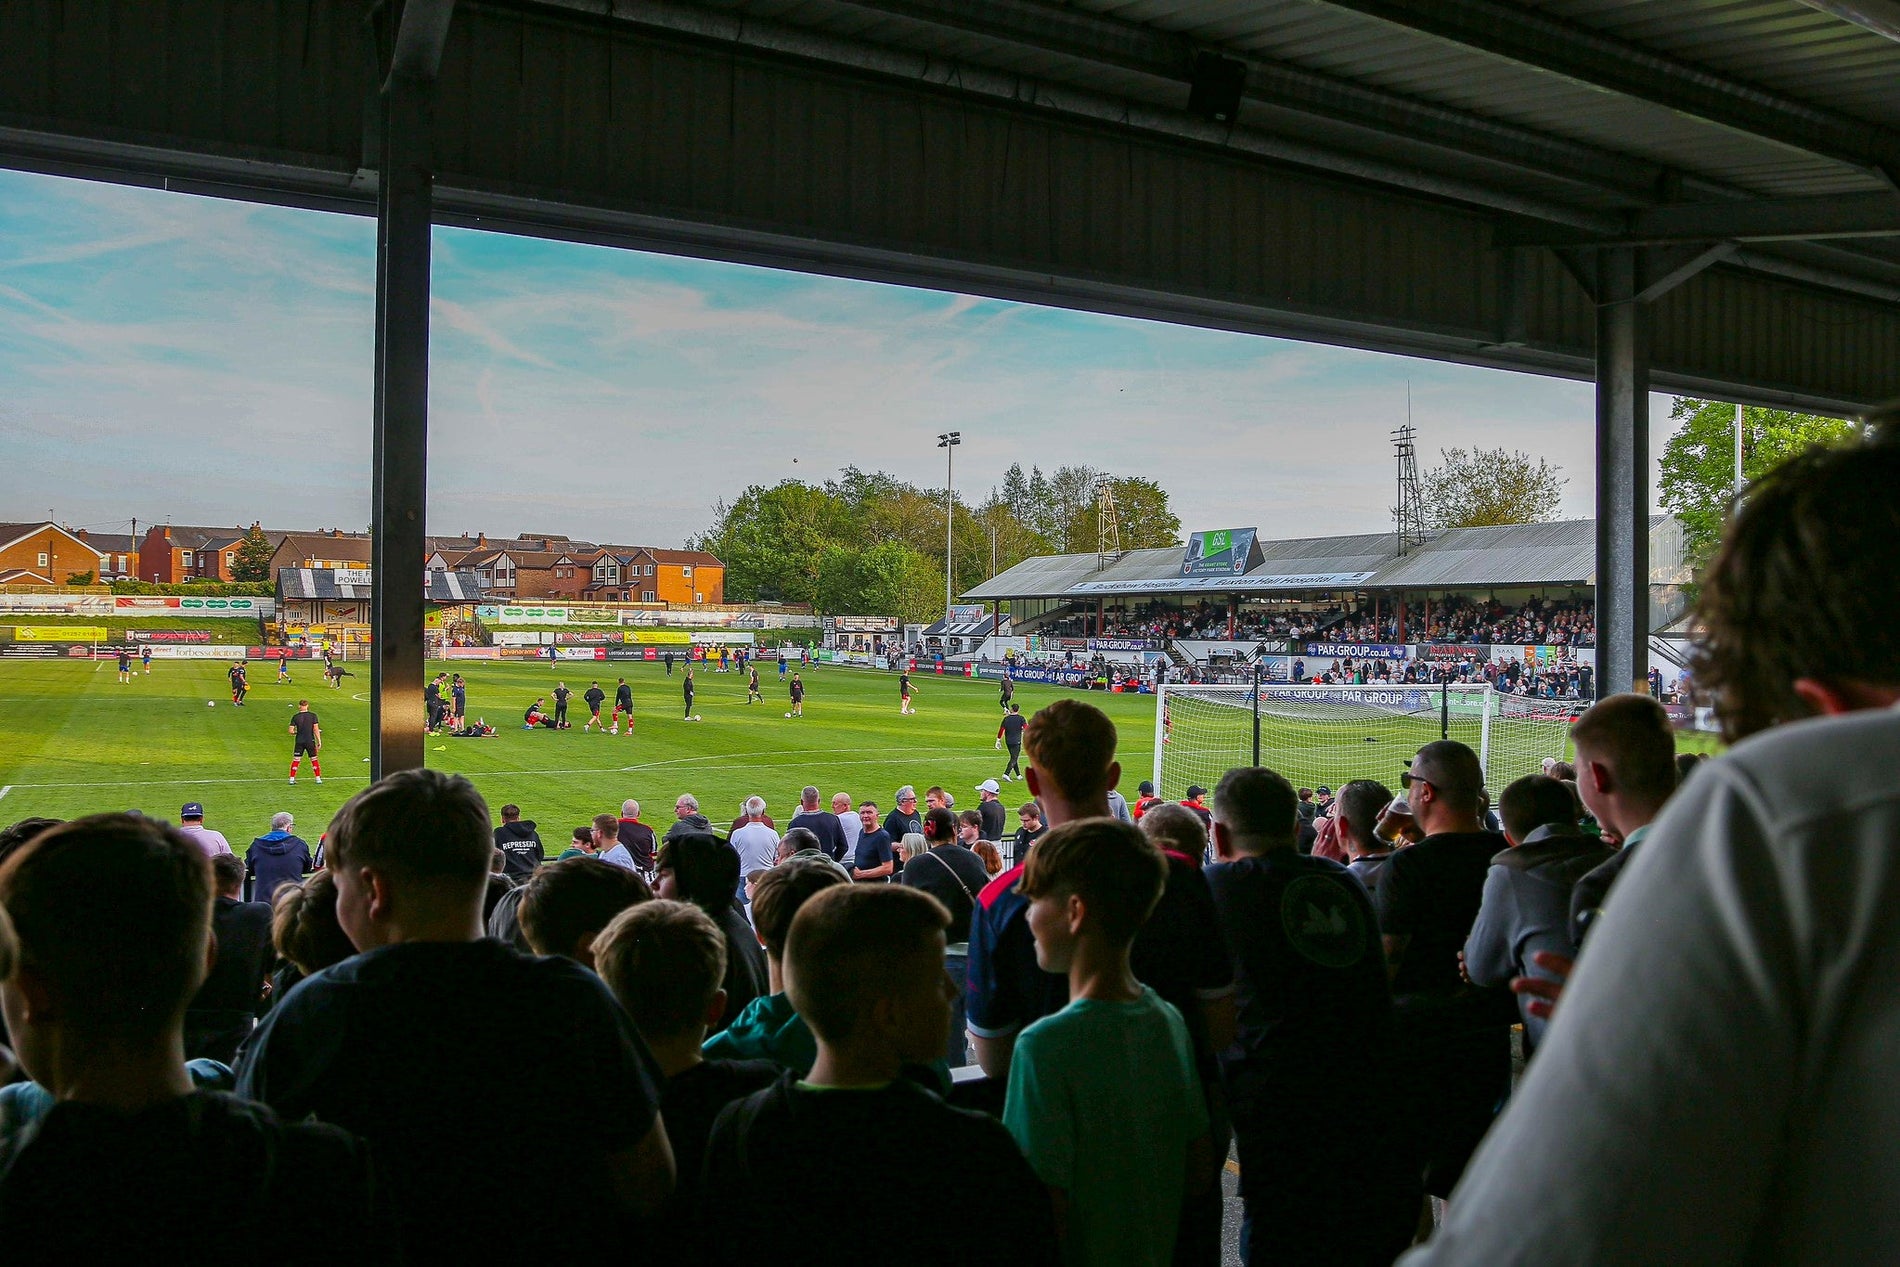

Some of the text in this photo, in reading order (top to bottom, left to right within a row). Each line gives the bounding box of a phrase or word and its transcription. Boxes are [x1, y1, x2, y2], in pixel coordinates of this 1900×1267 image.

[1140, 581, 1183, 590] Hospital
[1255, 576, 1281, 585] Hall
[1283, 575, 1335, 585] Hospital
[1318, 645, 1391, 657] PAR-GROUP.co.uk
[1342, 691, 1403, 704] PAR GROUP
[502, 840, 537, 851] REPRESEN
